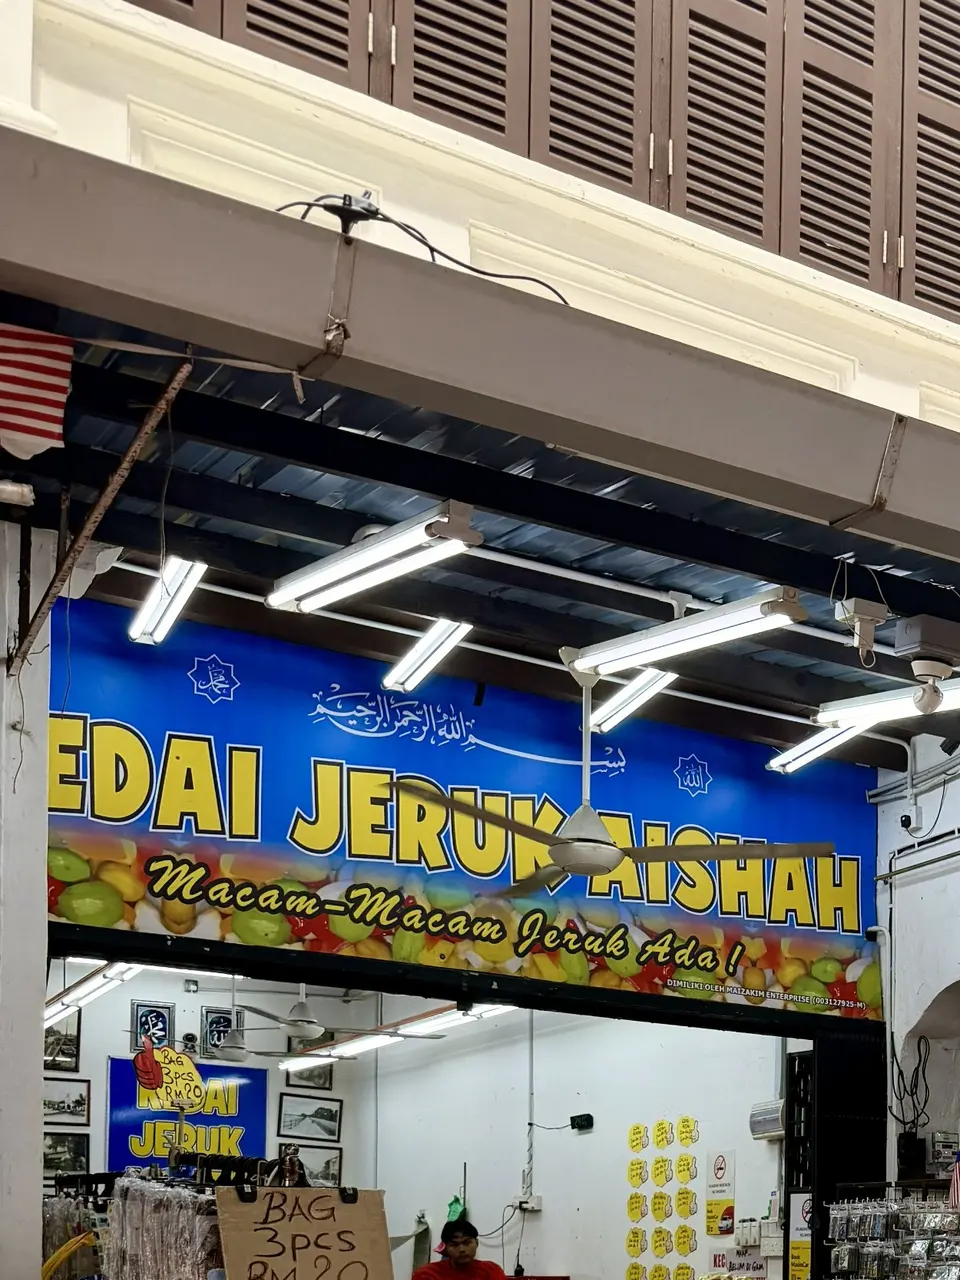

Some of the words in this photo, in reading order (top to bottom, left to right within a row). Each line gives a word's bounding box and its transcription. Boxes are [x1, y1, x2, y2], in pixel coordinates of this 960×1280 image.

[48, 712, 264, 842] EDAI
[287, 757, 572, 897] JERUK
[587, 810, 863, 936] AISHAH
[147, 858, 503, 942] Macam-Macam
[517, 910, 627, 958] Jeruk
[639, 926, 719, 969] Ada
[667, 979, 704, 991] DIMILIKI
[705, 984, 725, 993] OLEH
[726, 986, 765, 998] MAIZAKIM
[766, 991, 811, 1004] ENTERPRISE
[160, 1049, 185, 1066] BAG
[136, 1078, 240, 1116] KAI
[129, 1120, 246, 1158] JERUK
[253, 1191, 336, 1226] BAG
